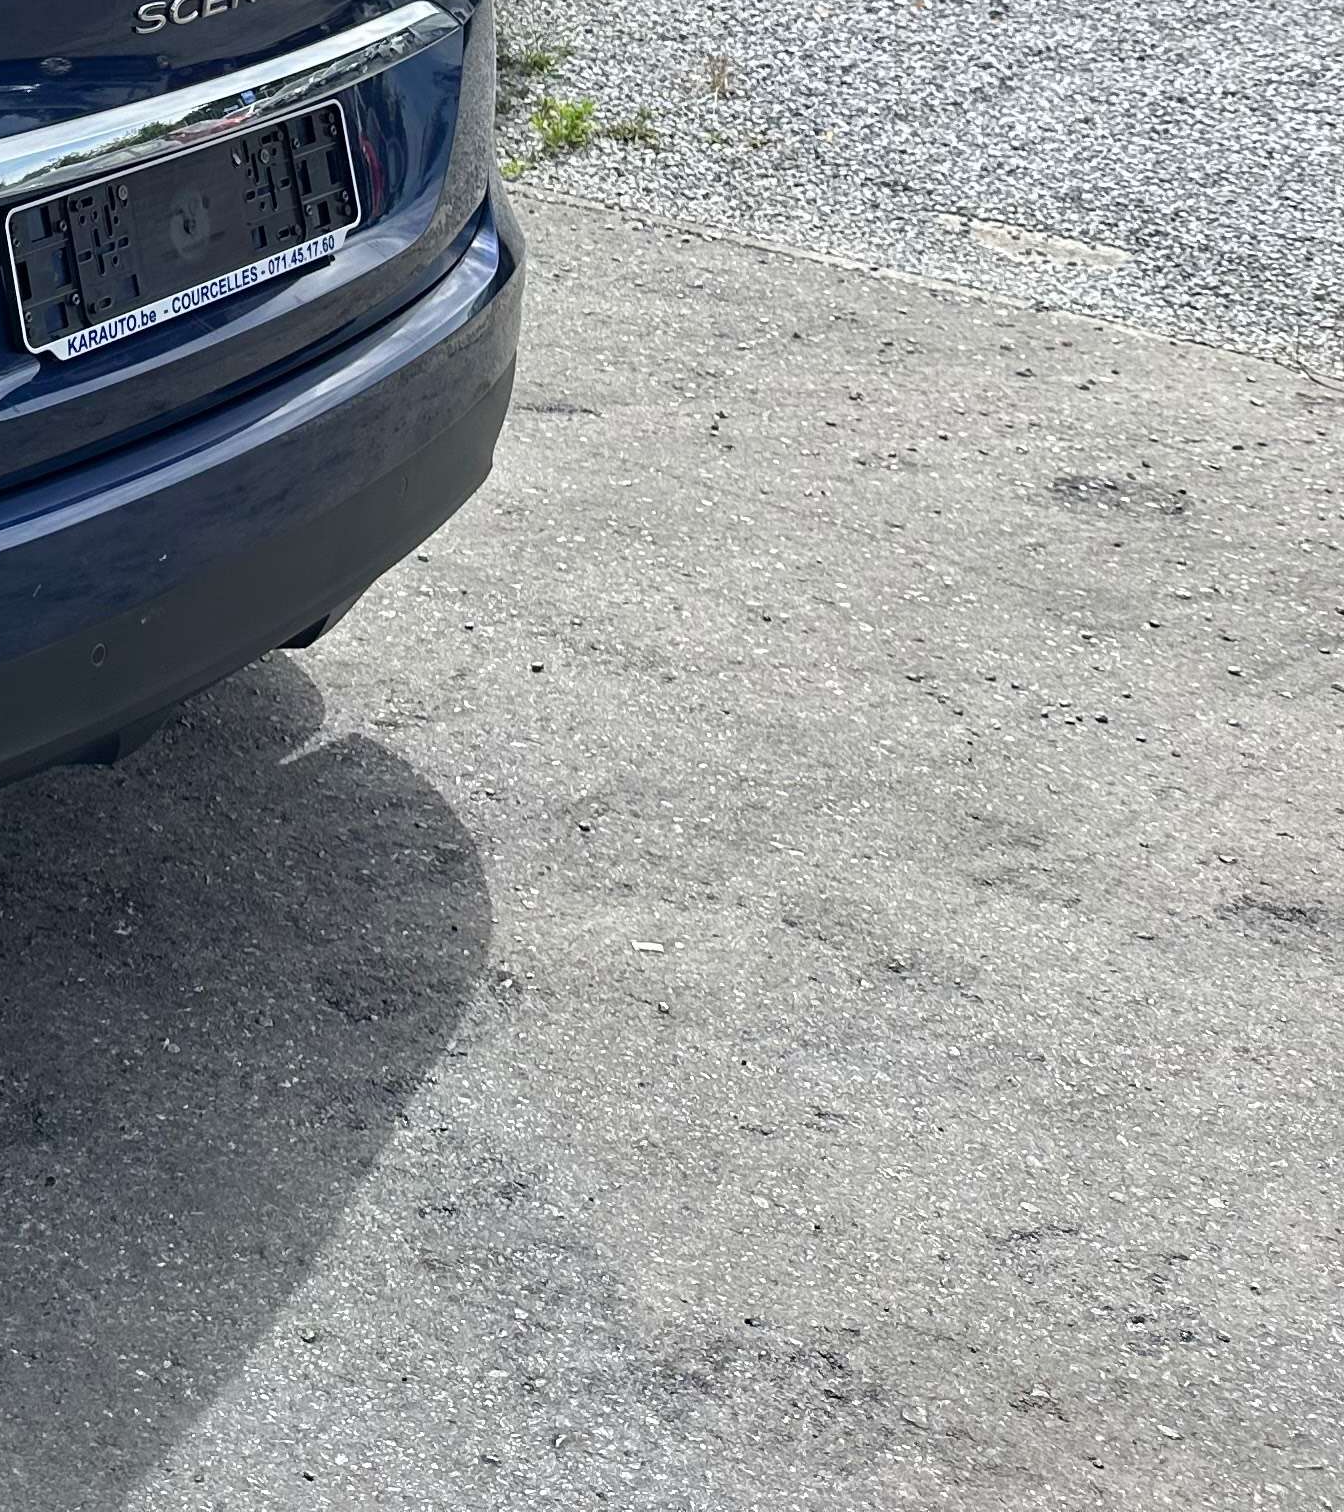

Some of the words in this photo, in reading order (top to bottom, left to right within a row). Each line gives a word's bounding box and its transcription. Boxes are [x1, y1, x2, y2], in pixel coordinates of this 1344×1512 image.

[67, 310, 157, 356] KARAUTO.be
[172, 266, 258, 313] COURCELLES
[268, 235, 335, 274] 071.45.17.60
